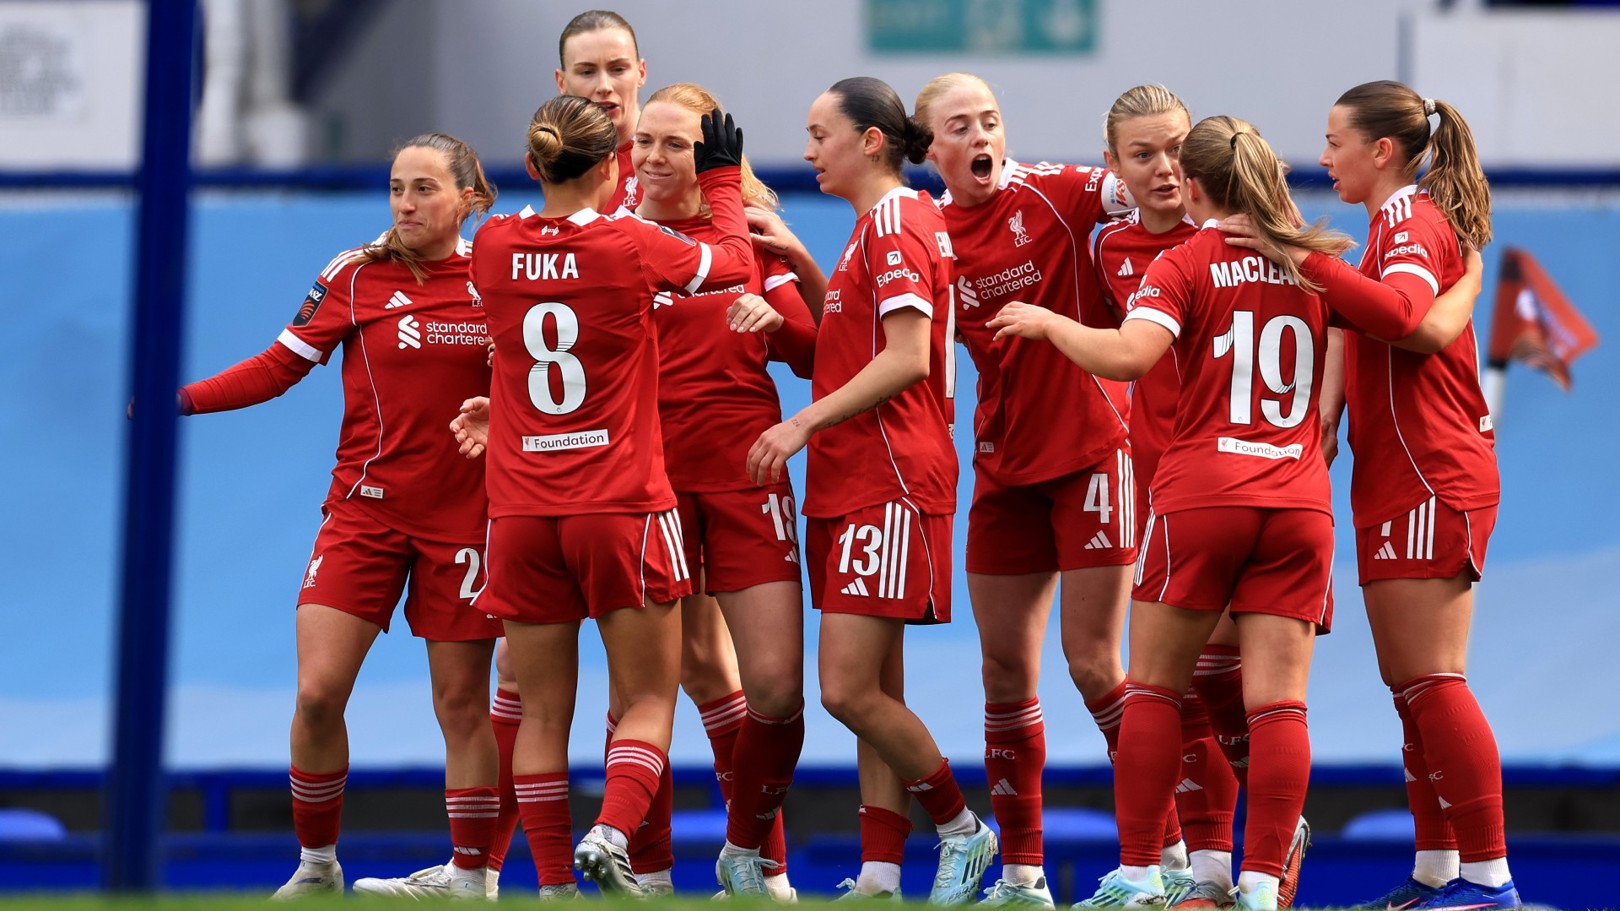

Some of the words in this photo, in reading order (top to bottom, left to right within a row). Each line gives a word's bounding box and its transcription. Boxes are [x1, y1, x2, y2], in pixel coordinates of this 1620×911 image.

[512, 253, 579, 280] FUKA
[976, 260, 1034, 289] standard
[980, 270, 1042, 300] chartered
[1135, 285, 1160, 299] edia
[426, 321, 487, 335] standard
[427, 333, 486, 346] chartere
[522, 301, 587, 416] 8
[1213, 311, 1315, 429] 19
[534, 433, 605, 450] Foundation
[1234, 441, 1301, 457] Foundation
[1083, 473, 1113, 525] 4
[838, 523, 883, 576] 13
[455, 547, 486, 599] 2
